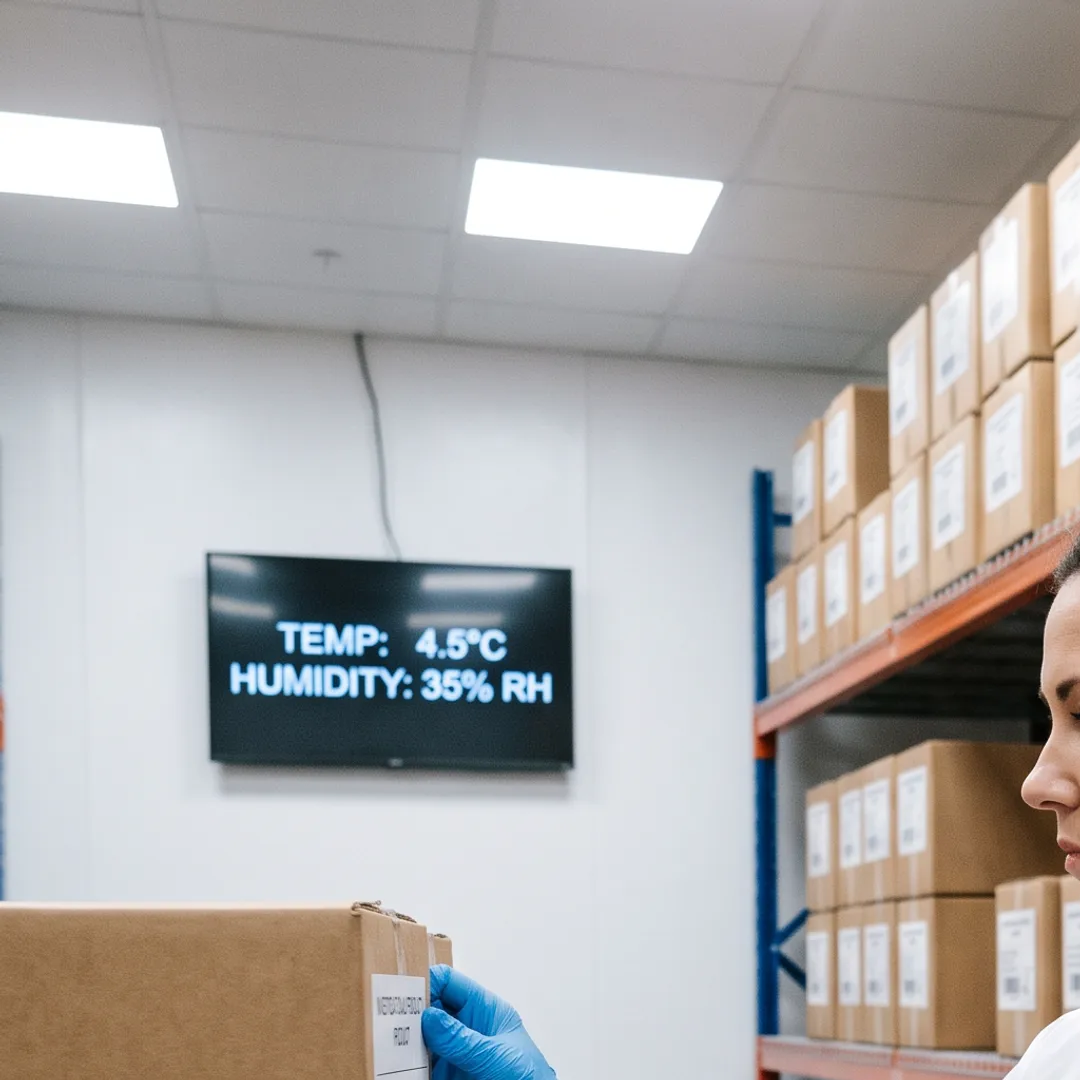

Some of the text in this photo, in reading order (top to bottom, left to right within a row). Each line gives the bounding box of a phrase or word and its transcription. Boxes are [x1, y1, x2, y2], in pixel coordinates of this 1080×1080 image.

[276, 621, 389, 658] TEMP:
[230, 662, 553, 704] HUMIDITY: 35% RH
